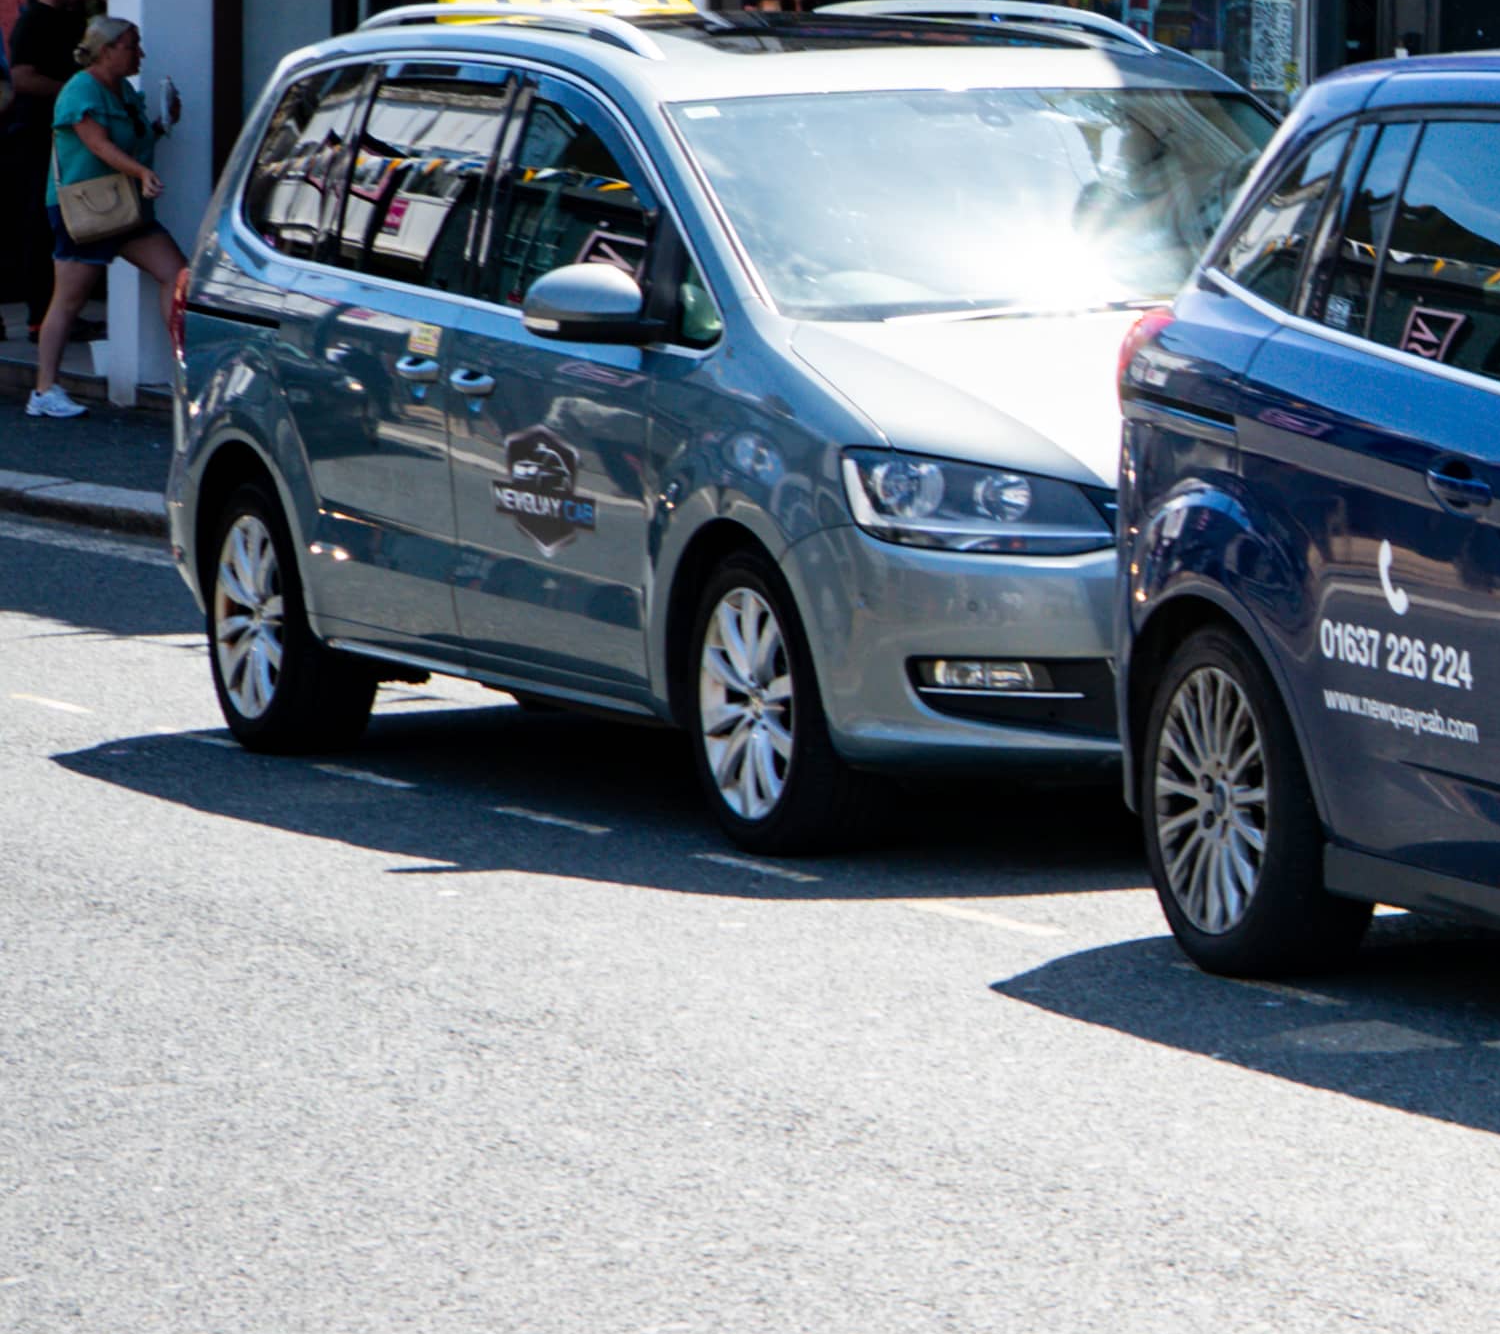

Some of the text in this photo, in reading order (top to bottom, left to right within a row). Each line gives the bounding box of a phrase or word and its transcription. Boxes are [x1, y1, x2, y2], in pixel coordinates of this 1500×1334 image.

[1320, 618, 1473, 691] 01637 226 224
[1323, 689, 1479, 745] www.newquaycab.com
